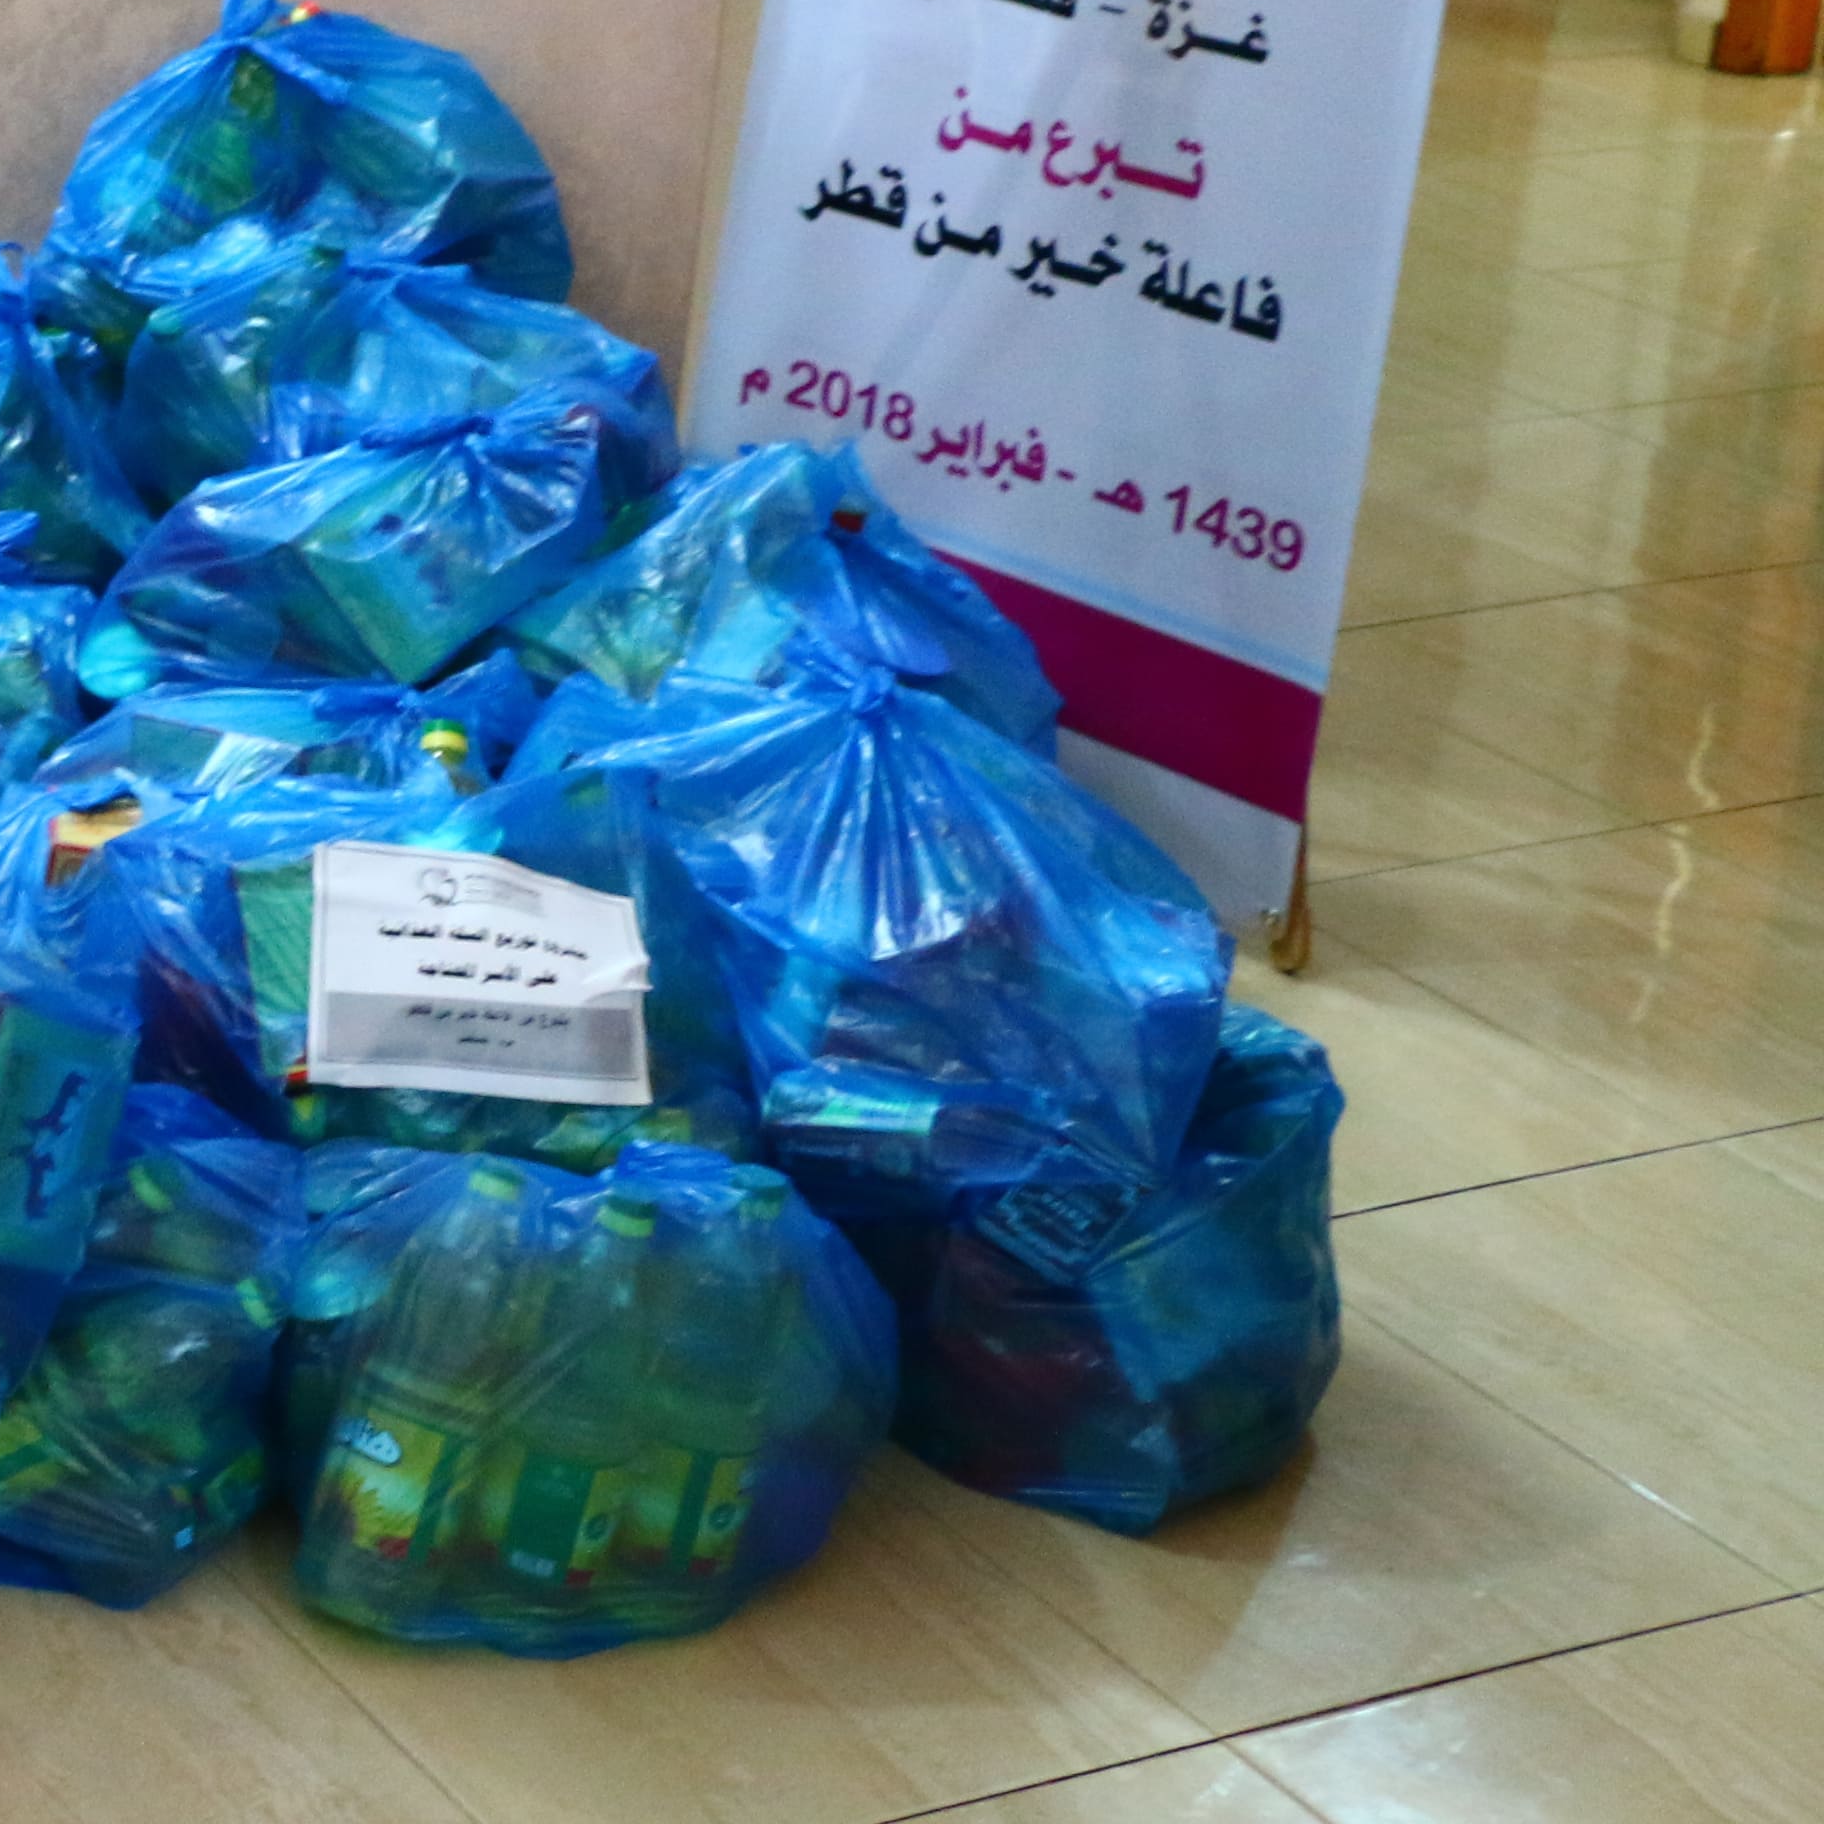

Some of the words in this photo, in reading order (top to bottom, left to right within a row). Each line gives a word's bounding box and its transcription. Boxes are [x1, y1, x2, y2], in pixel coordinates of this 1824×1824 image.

[936, 86, 1034, 154] من
[800, 158, 908, 230] قطر
[1040, 119, 1205, 200] تبرع
[912, 192, 1002, 258] من
[1008, 233, 1126, 299] خير
[1137, 238, 1282, 343] فاعلة
[739, 367, 771, 404] م
[782, 358, 915, 442] 2018
[915, 421, 1047, 492] فبراير
[1164, 483, 1305, 572] 1439
